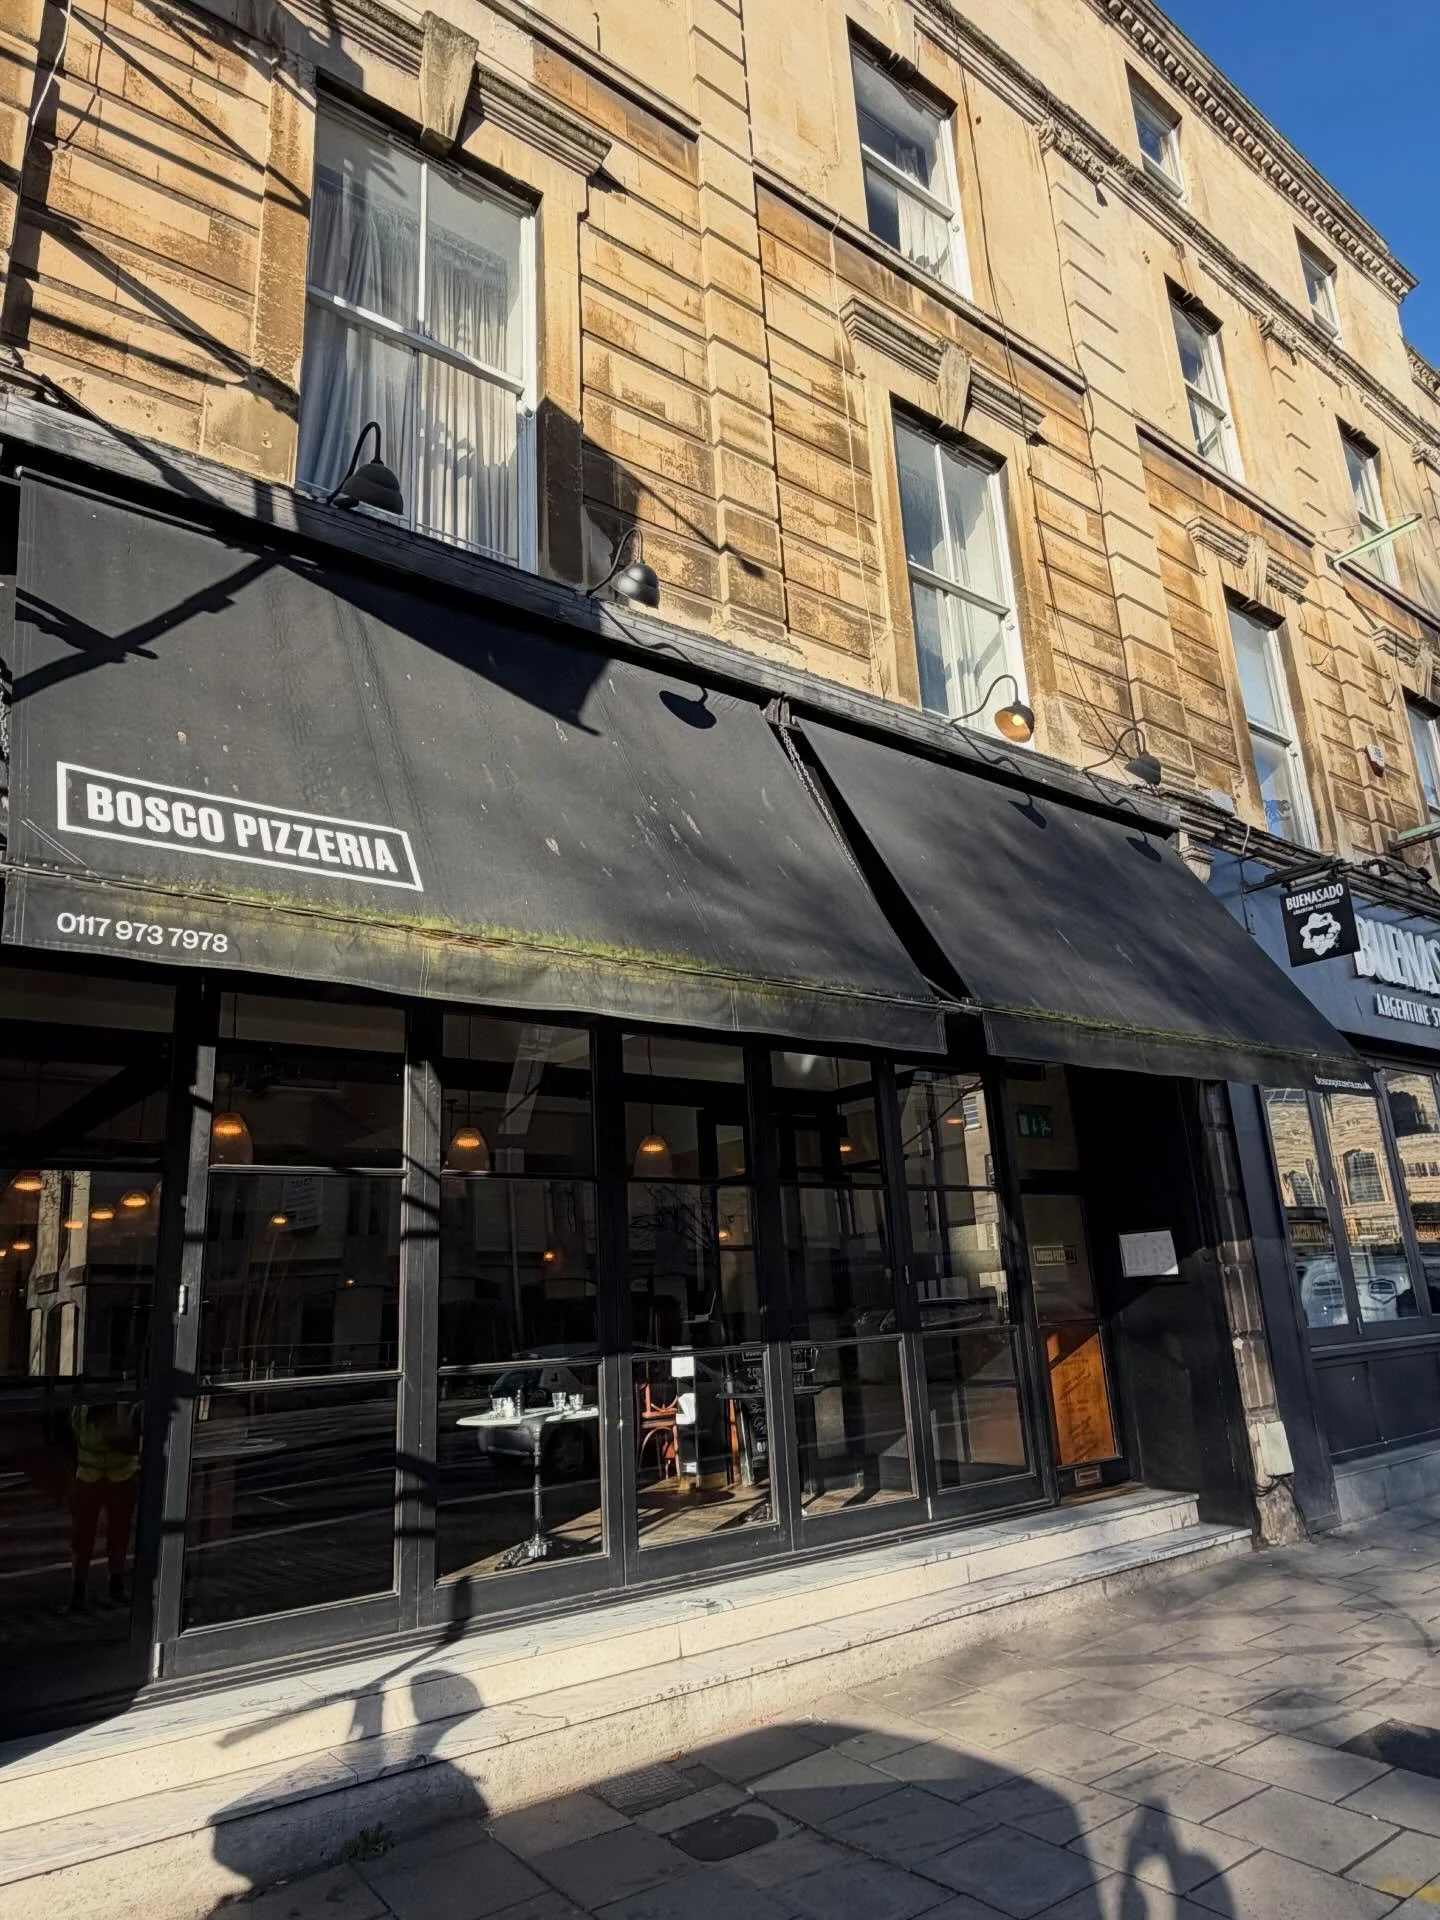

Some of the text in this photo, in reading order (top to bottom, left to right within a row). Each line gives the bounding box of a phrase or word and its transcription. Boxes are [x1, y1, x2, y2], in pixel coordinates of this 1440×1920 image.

[86, 783, 399, 874] BOSCO PIZZERIA
[1285, 883, 1344, 911] BUENASADO
[57, 911, 229, 953] 0117 973 7978
[1376, 992, 1431, 1025] ARGENTINE
